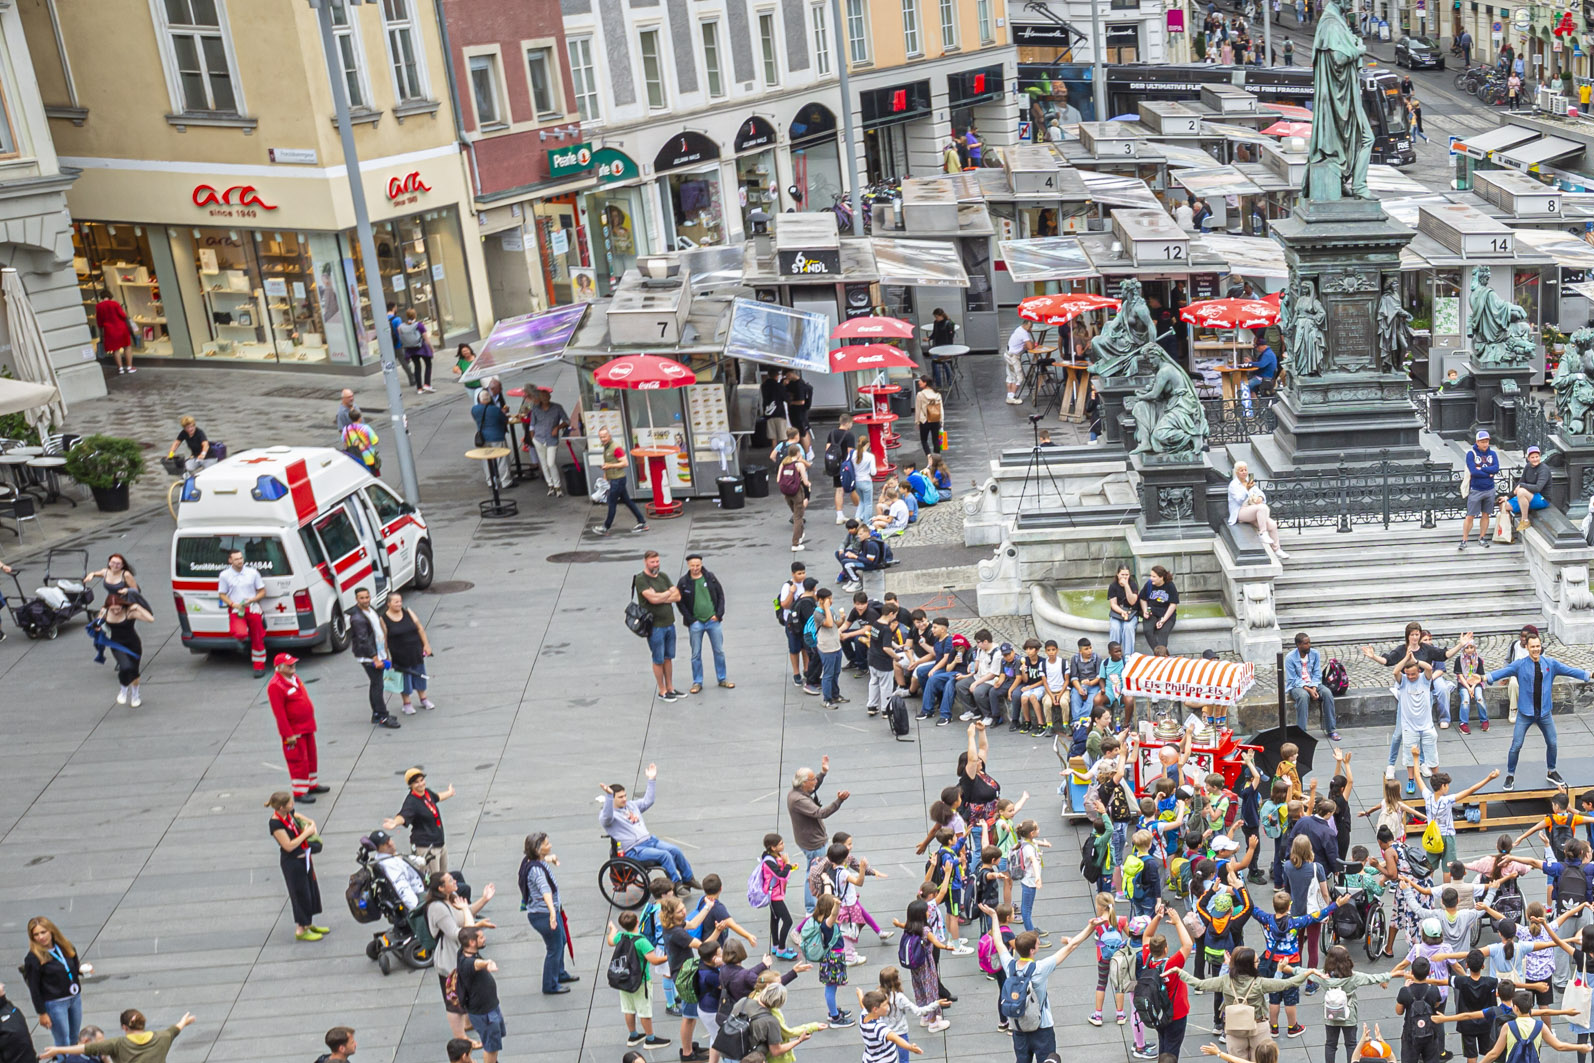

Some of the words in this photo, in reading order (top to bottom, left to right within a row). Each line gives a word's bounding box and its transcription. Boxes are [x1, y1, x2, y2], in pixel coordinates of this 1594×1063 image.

[1188, 120, 1195, 130] 2
[1124, 143, 1132, 155] 3
[553, 151, 577, 168] Pearle
[388, 171, 432, 200] ara
[1045, 176, 1054, 188] 4
[192, 184, 278, 211] ara
[1547, 200, 1556, 212] 8
[1163, 245, 1182, 260] 12
[1490, 238, 1508, 252] 14
[656, 321, 668, 338] 7
[1144, 680, 1163, 692] Eis
[1164, 682, 1204, 696] Philipp
[1207, 685, 1224, 696] Eis
